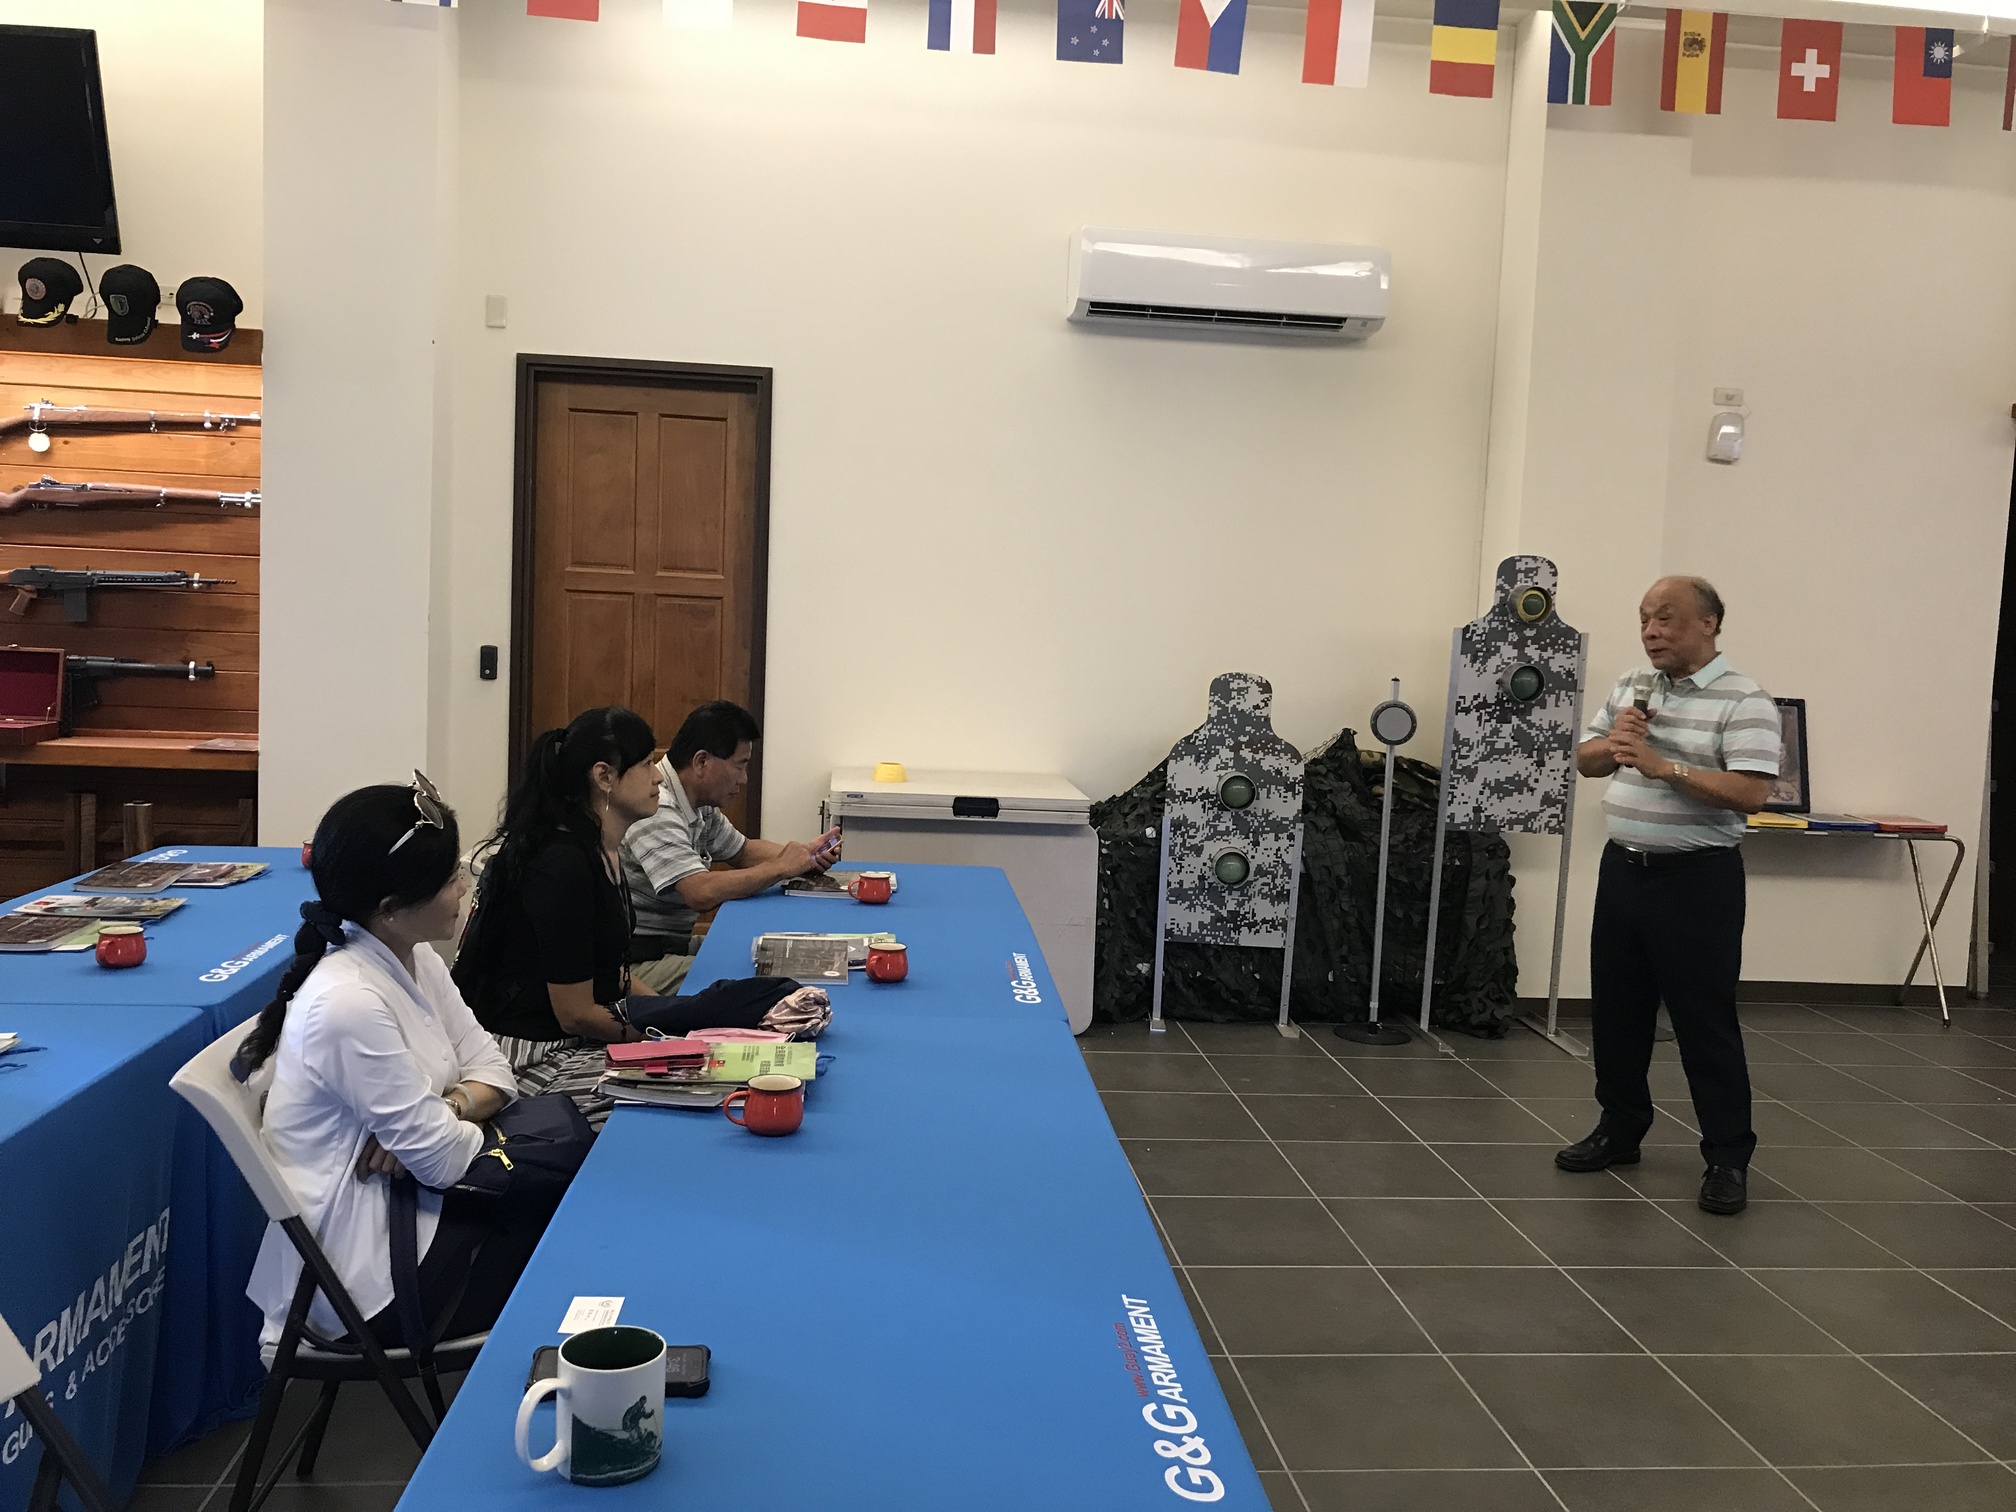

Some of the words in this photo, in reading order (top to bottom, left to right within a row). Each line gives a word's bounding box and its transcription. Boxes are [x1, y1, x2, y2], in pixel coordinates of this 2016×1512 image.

[1010, 980, 1042, 1004] G&G
[1121, 1294, 1188, 1404] ARMAMENT
[1142, 1402, 1225, 1502] G&G
